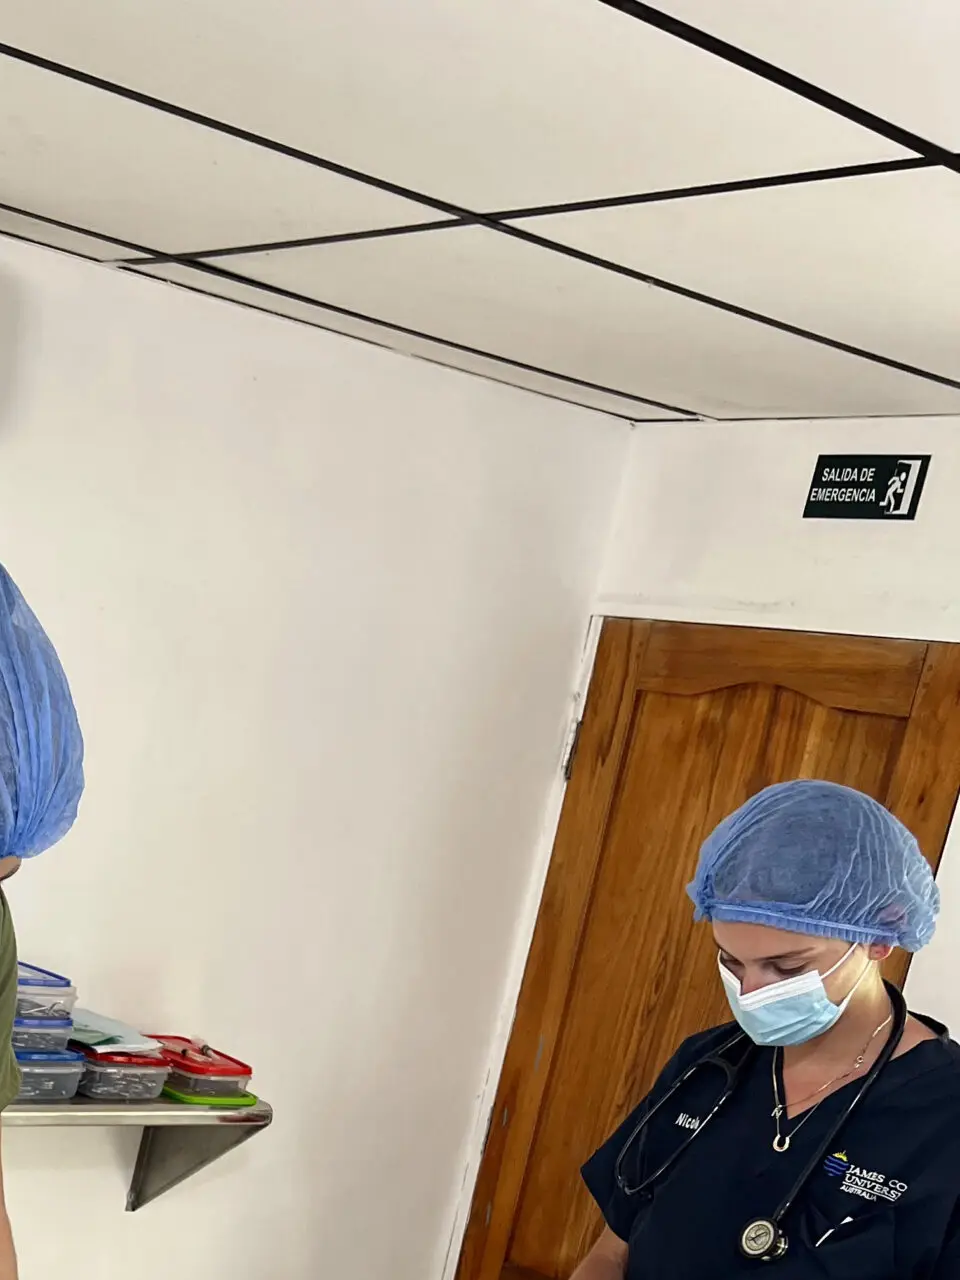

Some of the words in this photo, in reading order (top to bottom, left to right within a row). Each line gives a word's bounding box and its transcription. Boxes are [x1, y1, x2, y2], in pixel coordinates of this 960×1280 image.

[821, 467, 858, 482] SALIDA
[859, 467, 876, 482] DE
[809, 487, 876, 502] EMERGENCIA
[845, 1164, 886, 1183] JAMES
